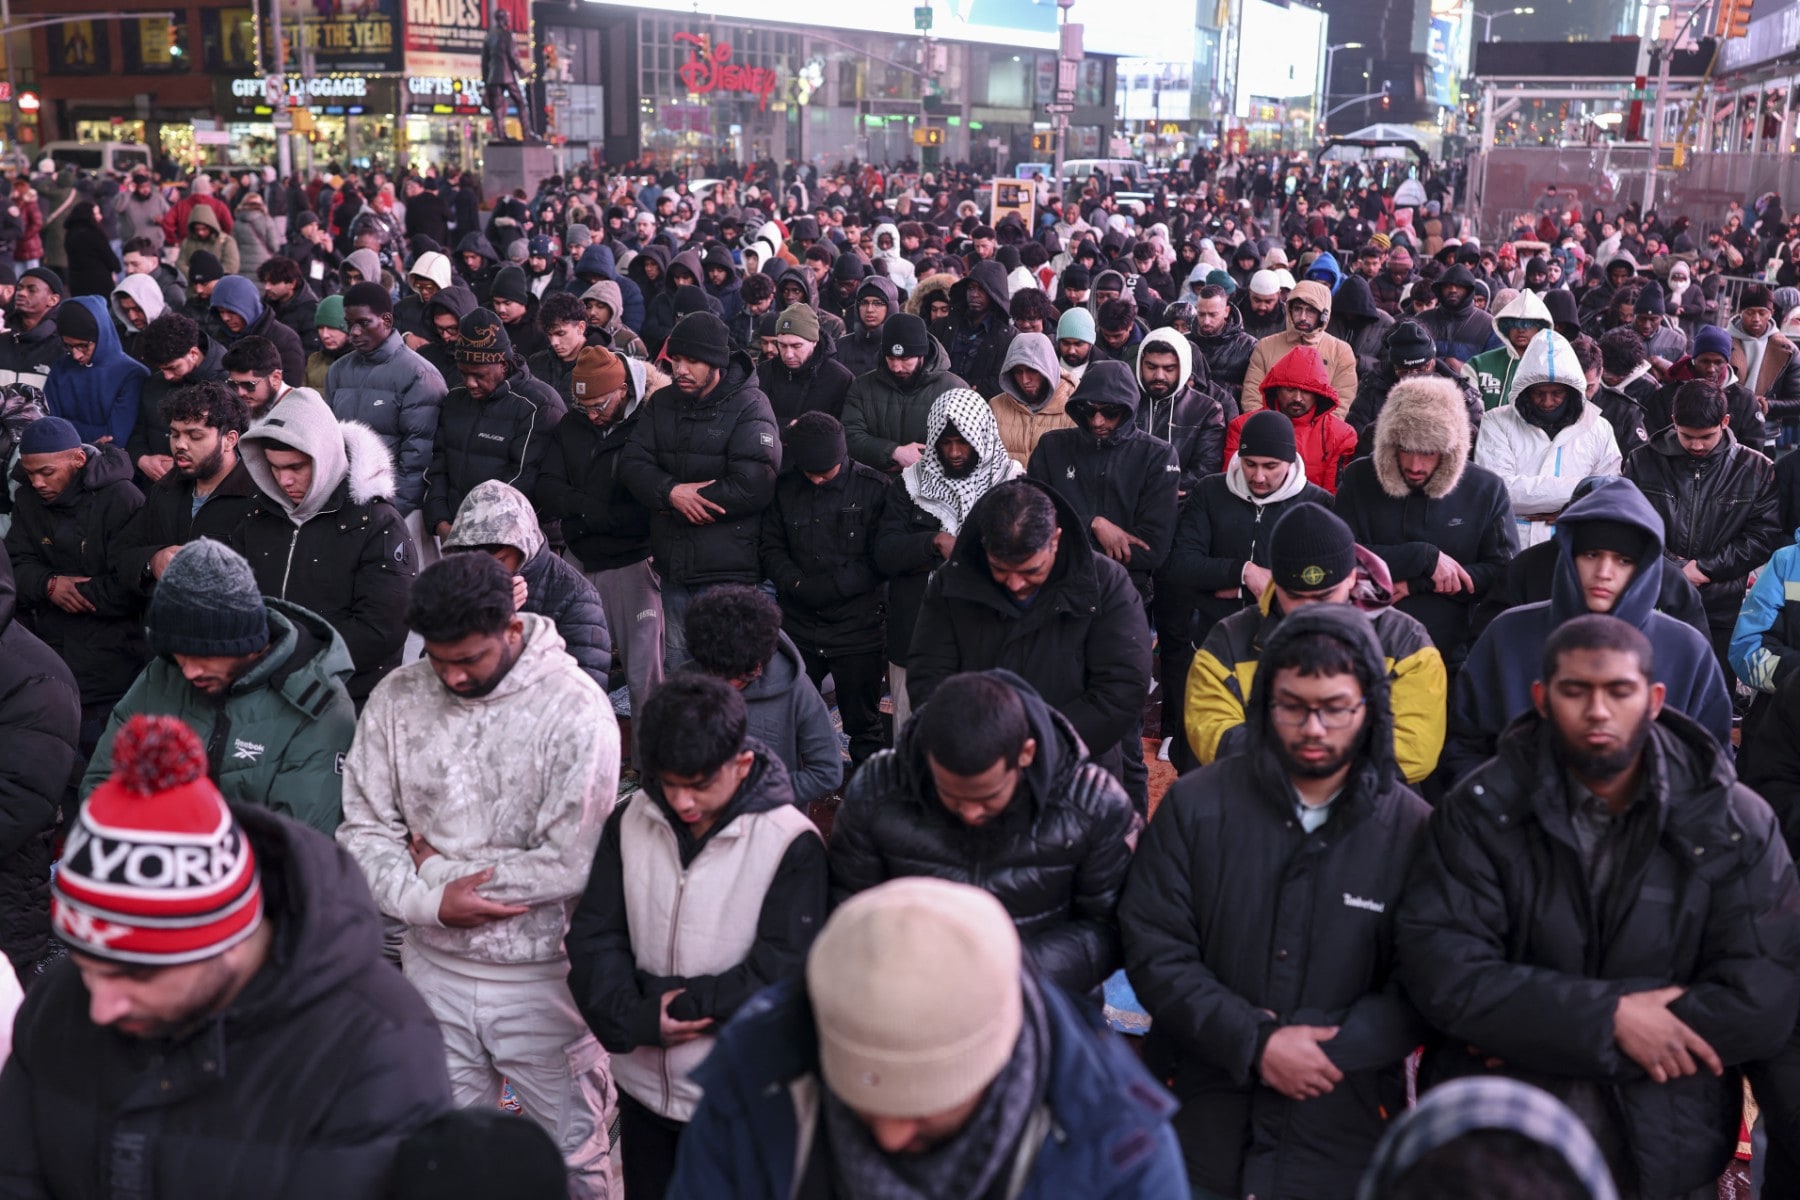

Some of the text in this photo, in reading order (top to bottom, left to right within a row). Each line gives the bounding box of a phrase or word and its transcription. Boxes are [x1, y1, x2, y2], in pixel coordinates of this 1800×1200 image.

[323, 23, 352, 48] THE
[353, 21, 392, 47] YEAR
[408, 77, 454, 95] GIFTS
[89, 832, 237, 889] YORK
